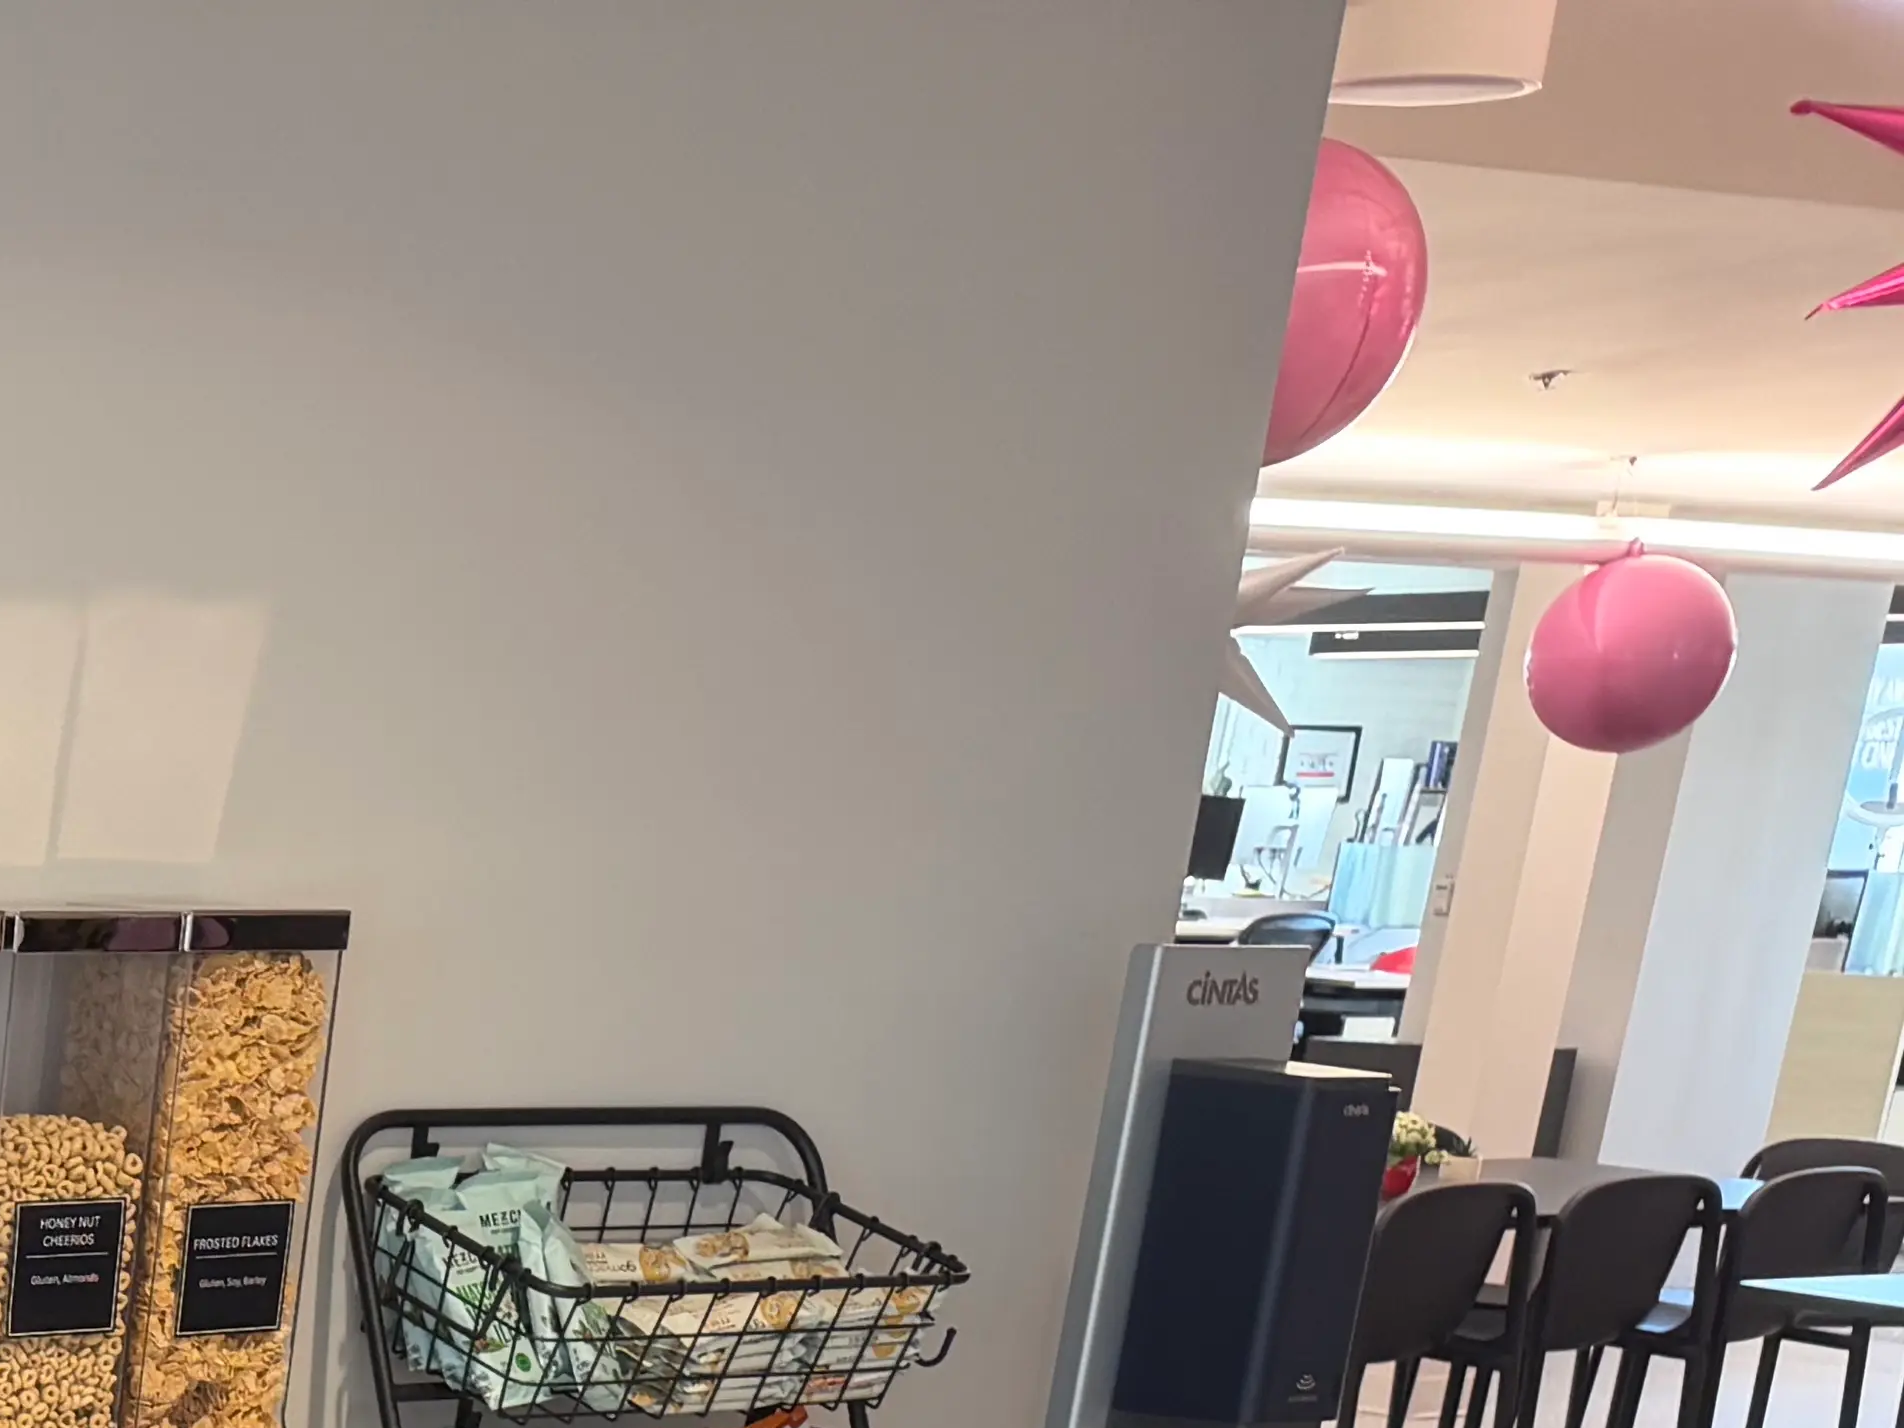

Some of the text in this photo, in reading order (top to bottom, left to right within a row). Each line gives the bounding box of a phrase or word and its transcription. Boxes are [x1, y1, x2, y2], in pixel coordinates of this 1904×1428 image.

[40, 1215, 101, 1230] HONEY NUT
[43, 1233, 95, 1247] CHEERIOS
[193, 1234, 279, 1250] FROSTED FLAKES
